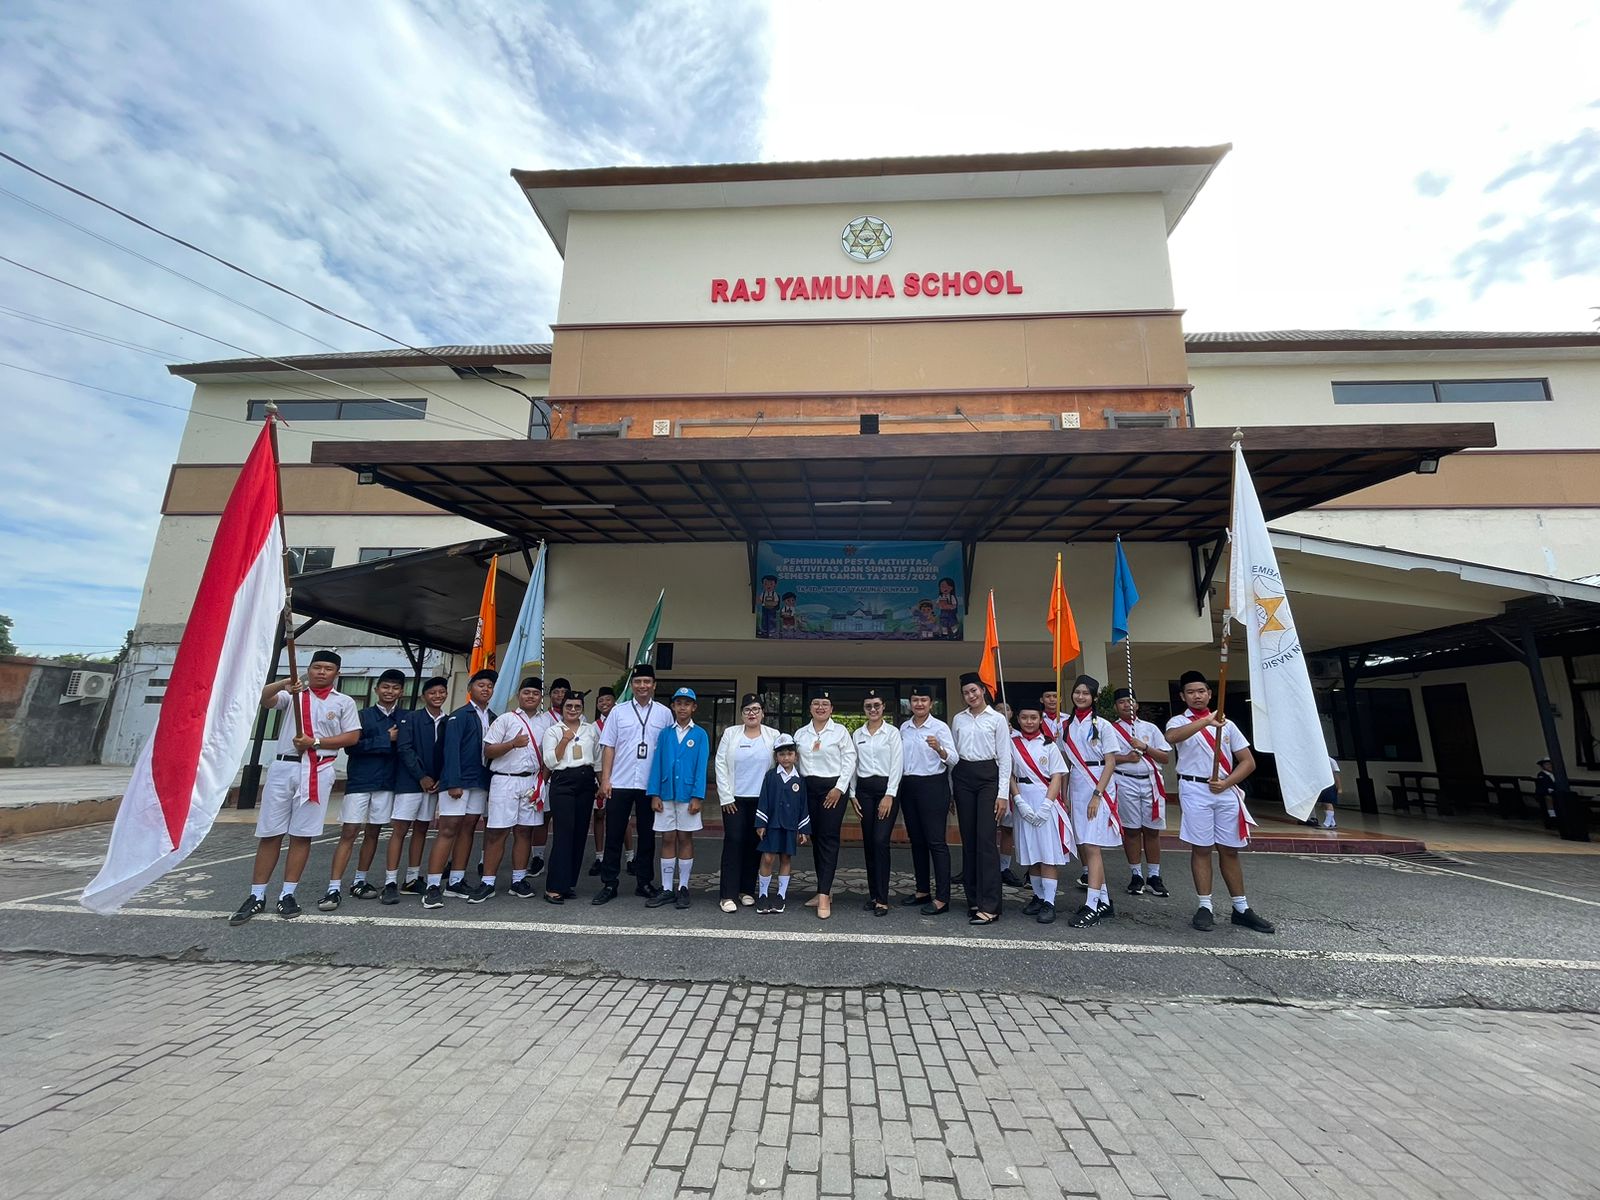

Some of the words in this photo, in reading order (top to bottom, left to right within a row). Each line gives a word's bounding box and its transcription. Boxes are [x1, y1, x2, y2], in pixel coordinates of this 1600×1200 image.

[711, 278, 766, 302] RAJ
[775, 274, 895, 300] YAMUNA
[903, 270, 1023, 296] SCHOOL
[865, 565, 909, 573] SUMATIF
[777, 572, 828, 580] SEMESTER
[829, 572, 865, 580] GANJIL
[880, 573, 937, 581] 2025/2026
